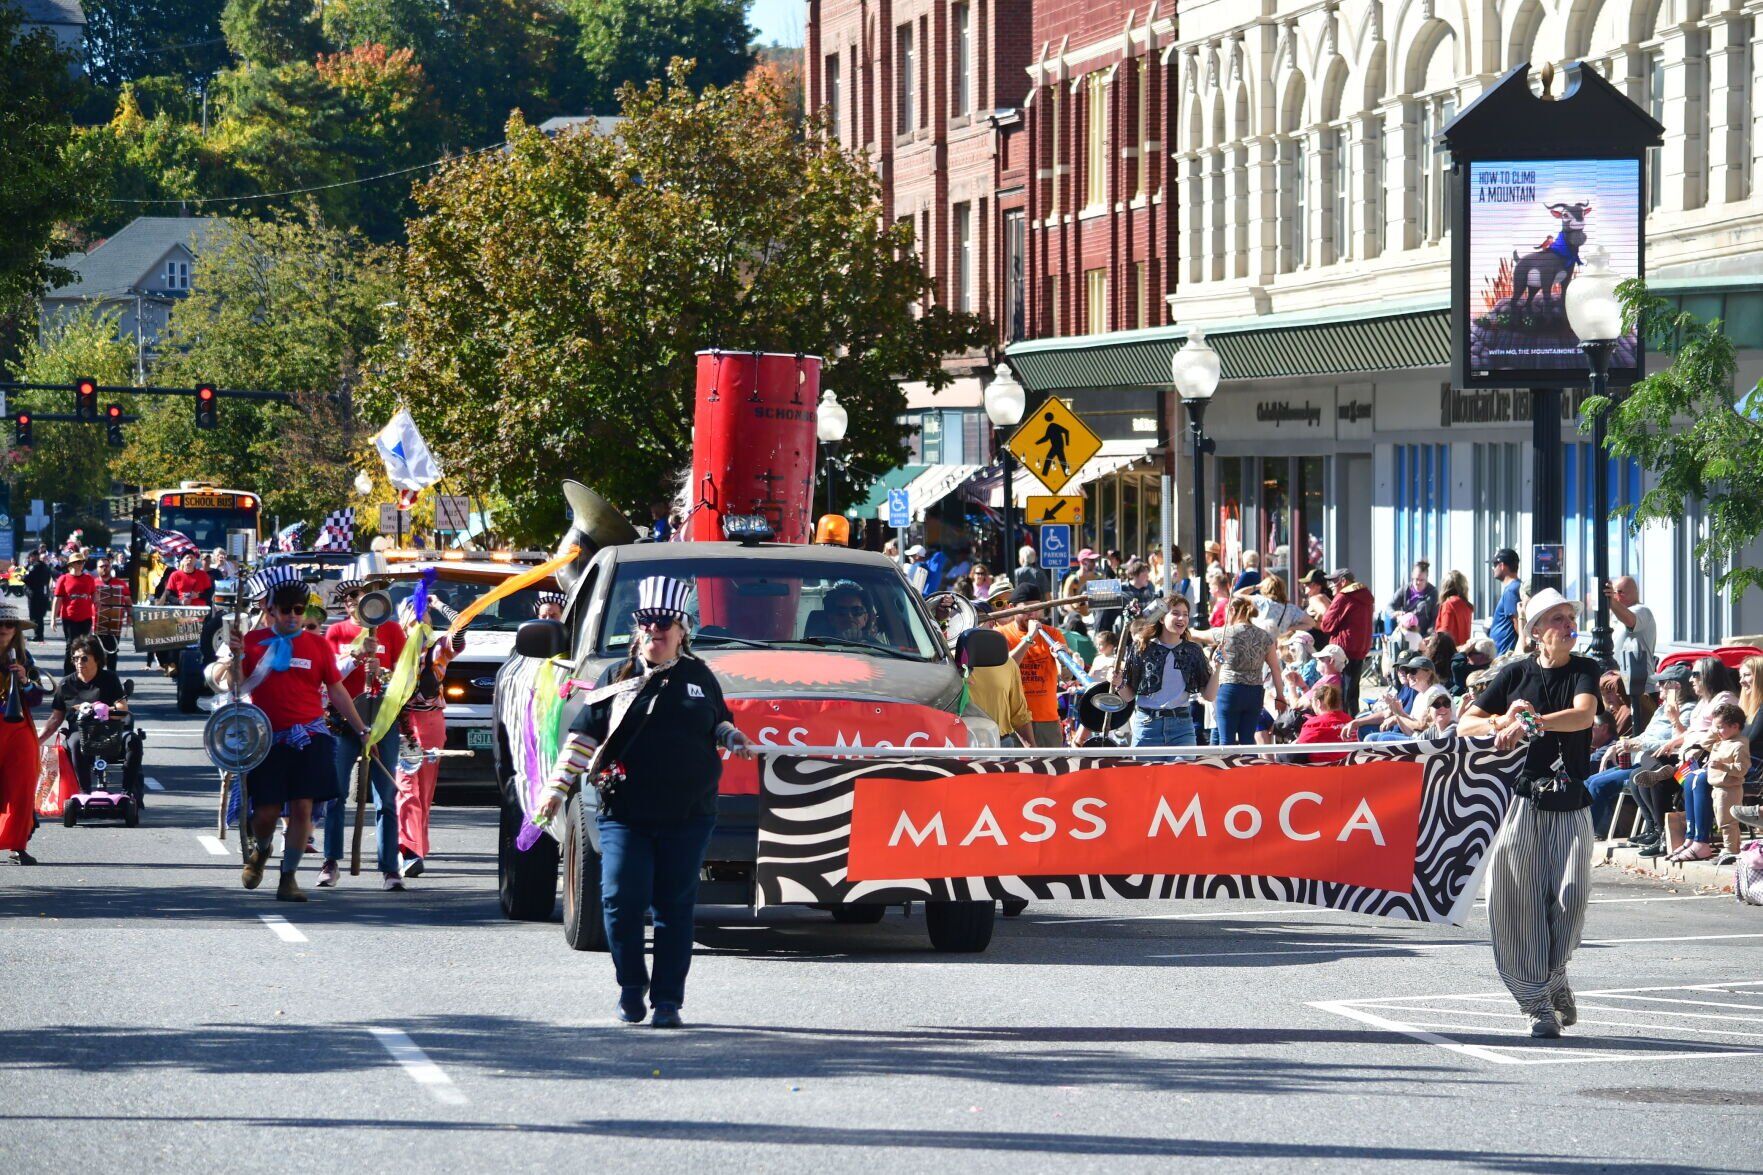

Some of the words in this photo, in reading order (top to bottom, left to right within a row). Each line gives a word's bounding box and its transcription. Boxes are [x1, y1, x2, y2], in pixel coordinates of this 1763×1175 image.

[1479, 171, 1498, 184] HOW
[1500, 171, 1510, 184] TO
[1512, 171, 1536, 184] CLIMB
[1479, 186, 1485, 203] A
[1488, 186, 1536, 202] MOUNTAIN
[184, 497, 216, 507] SCHOOL
[218, 497, 232, 507] BUS
[140, 610, 169, 621] FIFE
[172, 609, 182, 618] &
[888, 797, 1108, 847] MASS
[1147, 791, 1386, 847] MoCA
